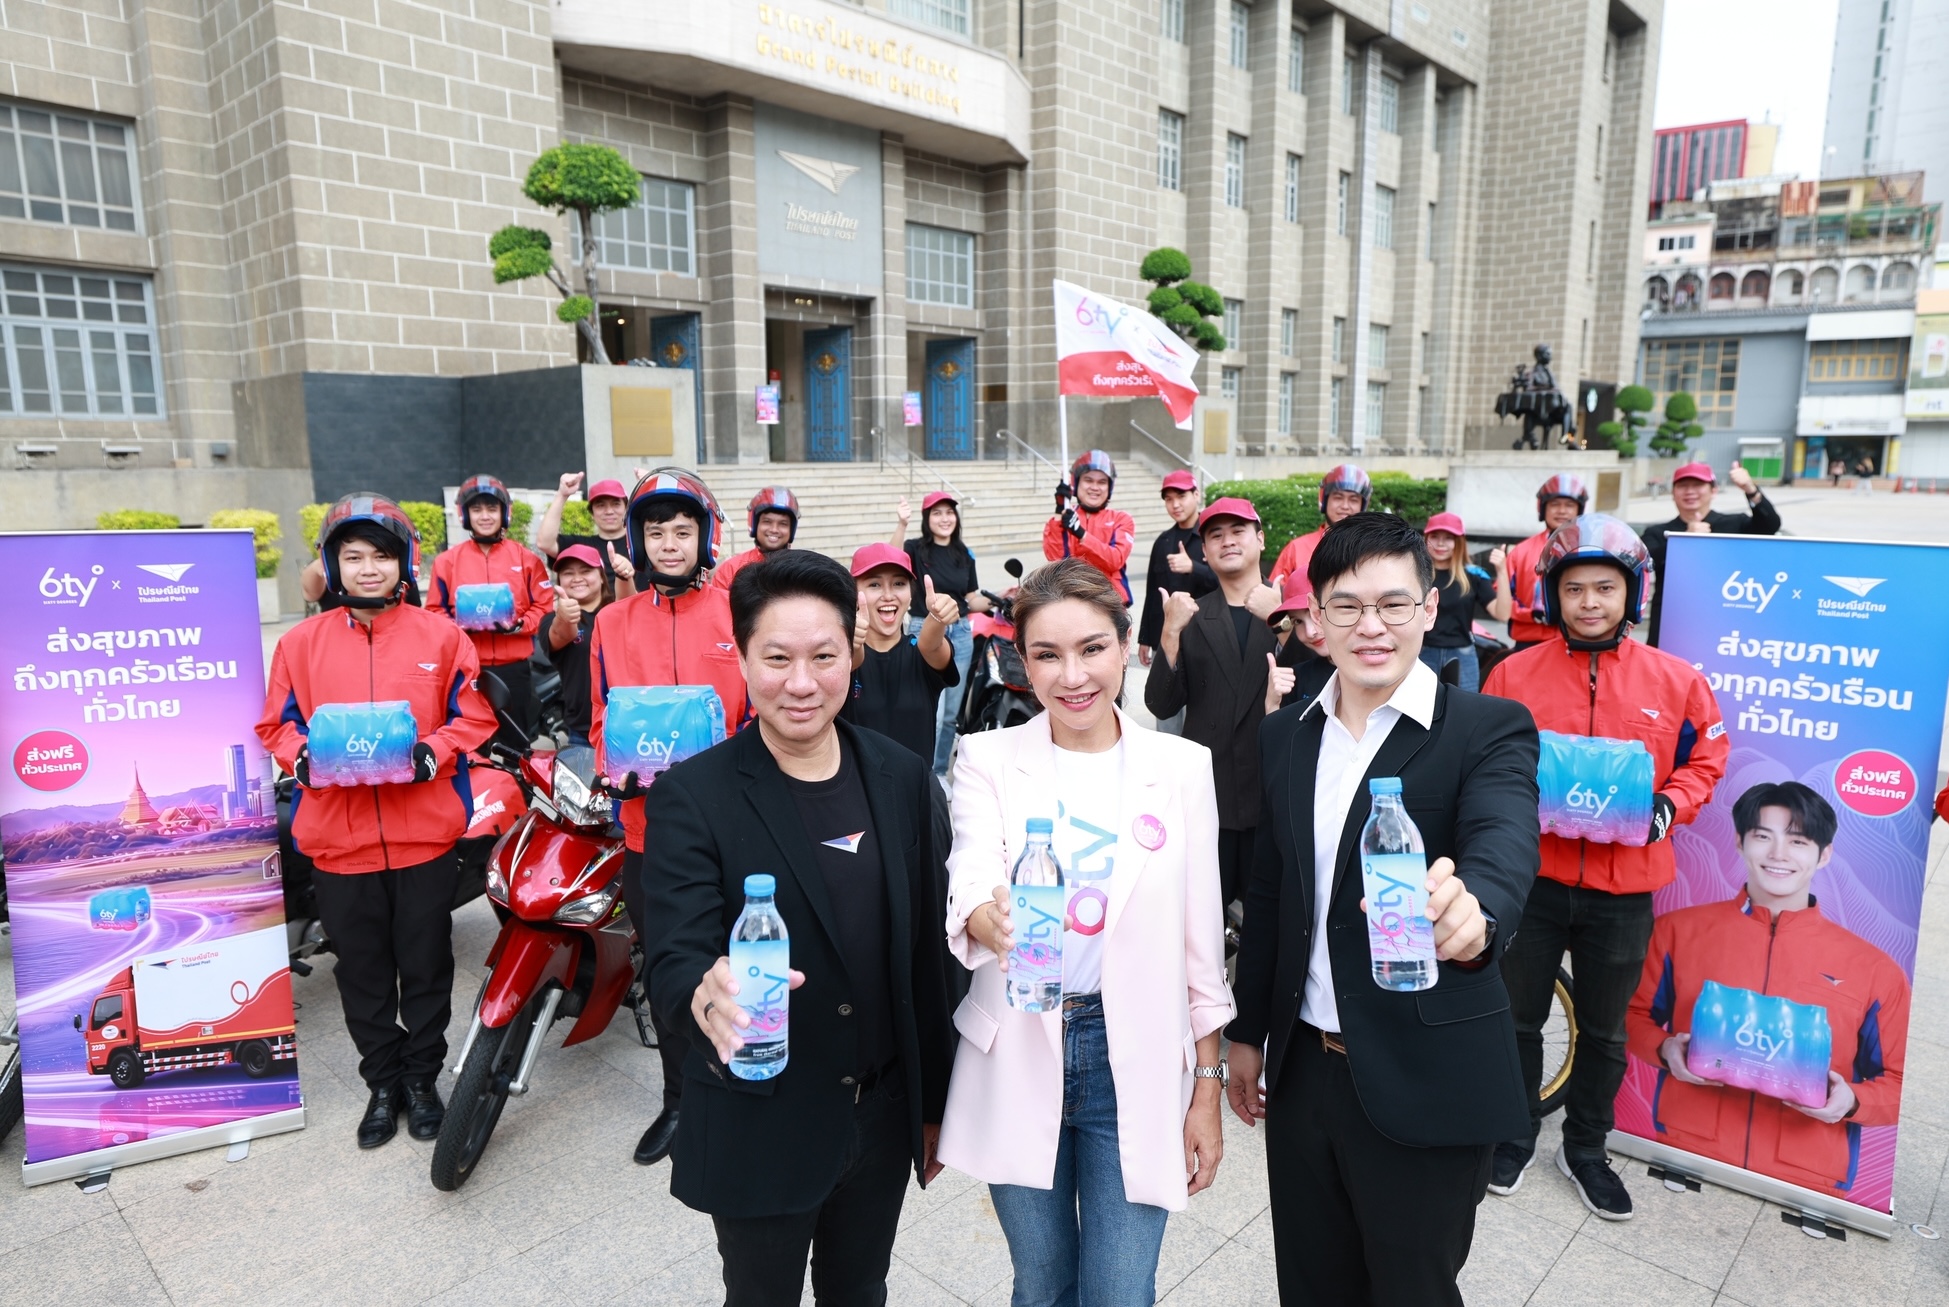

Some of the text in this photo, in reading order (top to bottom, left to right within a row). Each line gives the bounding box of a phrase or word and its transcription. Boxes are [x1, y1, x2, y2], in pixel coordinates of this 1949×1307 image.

[757, 33, 962, 114] Grand Postal Building
[785, 221, 857, 241] THAILAND POST
[137, 585, 200, 596] ไปรษณีย์ไทย
[138, 596, 169, 604] Thailand
[1816, 609, 1870, 620] Thailand Post
[1817, 598, 1887, 613] ไปรษณีย์ไทย
[47, 626, 202, 657] ส่งสุขภาพ
[1716, 630, 1880, 669] ส่งสุขภาพ
[13, 655, 238, 696] ถึงทุกครัวเรือน
[83, 691, 181, 723] ทั่วไทย
[1737, 699, 1840, 742] ทั่วไทย
[26, 744, 75, 762] ส่งฟรี
[21, 761, 83, 775] ทั่วประเทศ
[1849, 766, 1902, 786] ส่งฟรี
[1841, 781, 1907, 801] ทั่วประเทศ
